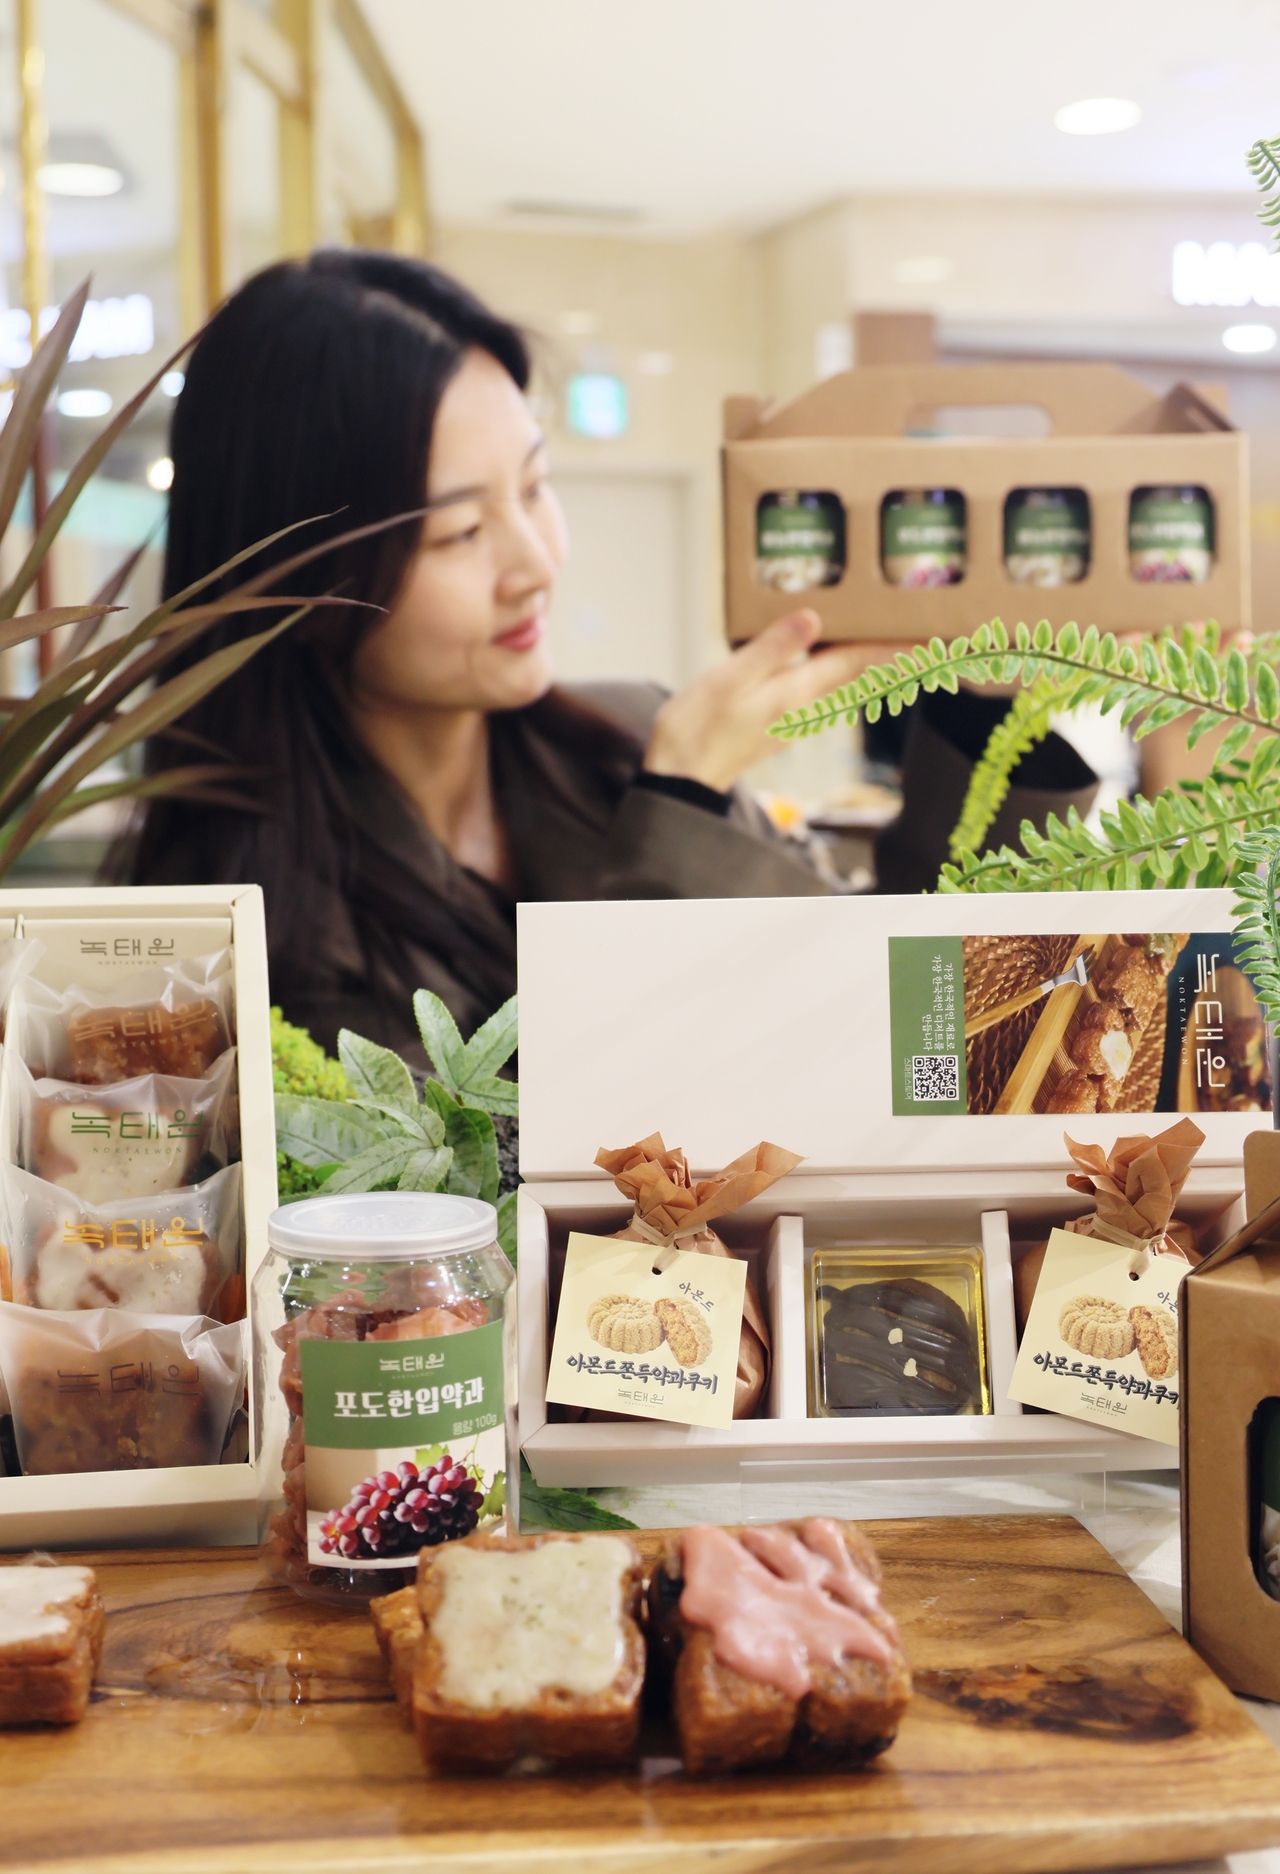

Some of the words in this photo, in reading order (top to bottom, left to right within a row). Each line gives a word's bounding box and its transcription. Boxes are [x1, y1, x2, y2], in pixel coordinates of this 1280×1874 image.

[80, 938, 174, 956] 녹태원
[932, 954, 942, 973] 가장
[944, 963, 954, 981] 가장
[933, 976, 943, 1011] 한국적인
[944, 984, 955, 1020] 한국적인
[75, 999, 207, 1041] 녹태원
[922, 1014, 933, 1051] 만듭니다
[934, 1015, 944, 1051] 디저트를
[1178, 976, 1188, 1065] NOKTAEWON
[1194, 954, 1226, 1087] 녹태원
[945, 1023, 955, 1050] 재료로
[71, 1109, 204, 1139] 녹태원
[93, 1147, 182, 1155] NOKTAEWON
[63, 1216, 203, 1249] 녹태원
[679, 1281, 714, 1312] 아몬드
[379, 1352, 445, 1372] 녹태원
[567, 1352, 718, 1395] 아몬드쫀득약과쿠키
[57, 1362, 200, 1396] 녹태원
[333, 1376, 485, 1418] 포도한입약과
[618, 1388, 664, 1405] 녹태원
[1080, 1392, 1128, 1415] 녹태원
[475, 1413, 497, 1428] 100g
